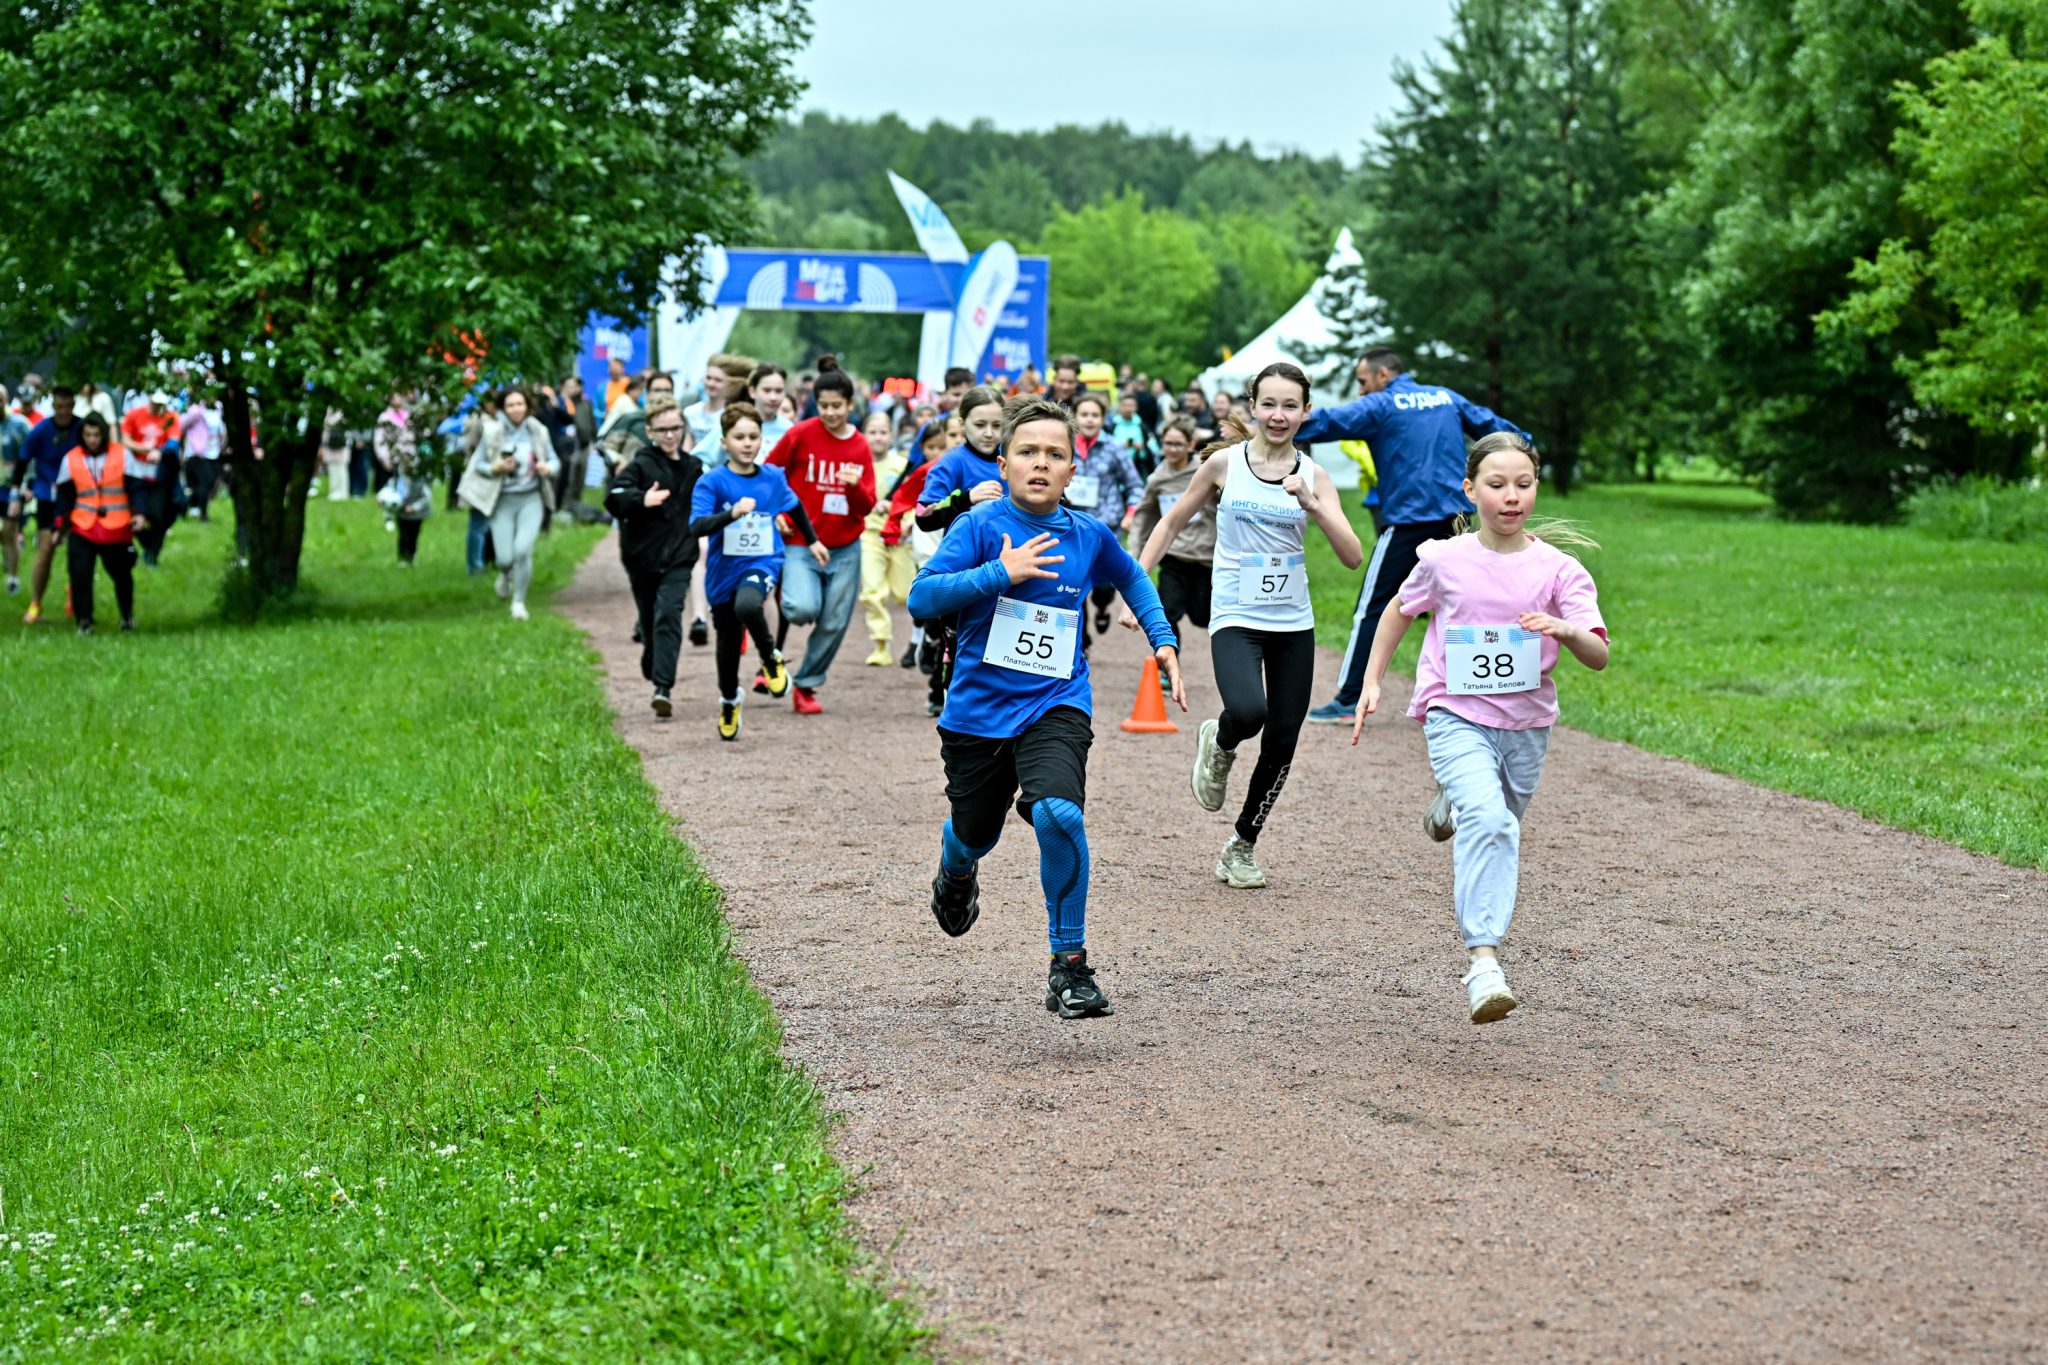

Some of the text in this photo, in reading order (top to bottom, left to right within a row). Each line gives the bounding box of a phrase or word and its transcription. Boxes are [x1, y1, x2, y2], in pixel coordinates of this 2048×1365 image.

[1393, 390, 1454, 411] СУДЬЯ
[1231, 500, 1259, 510] ИНГО
[1261, 503, 1302, 517] СОЦИУМ
[1275, 521, 1297, 531] 2025
[738, 533, 761, 548] 52
[1261, 574, 1289, 593] 57
[1036, 609, 1049, 619] Мед
[1484, 630, 1499, 638] Мед
[1015, 631, 1055, 660] 55
[1003, 655, 1057, 673] Платон Ступин
[1472, 653, 1514, 679] 38
[1462, 680, 1526, 690] Татьяна Белова
